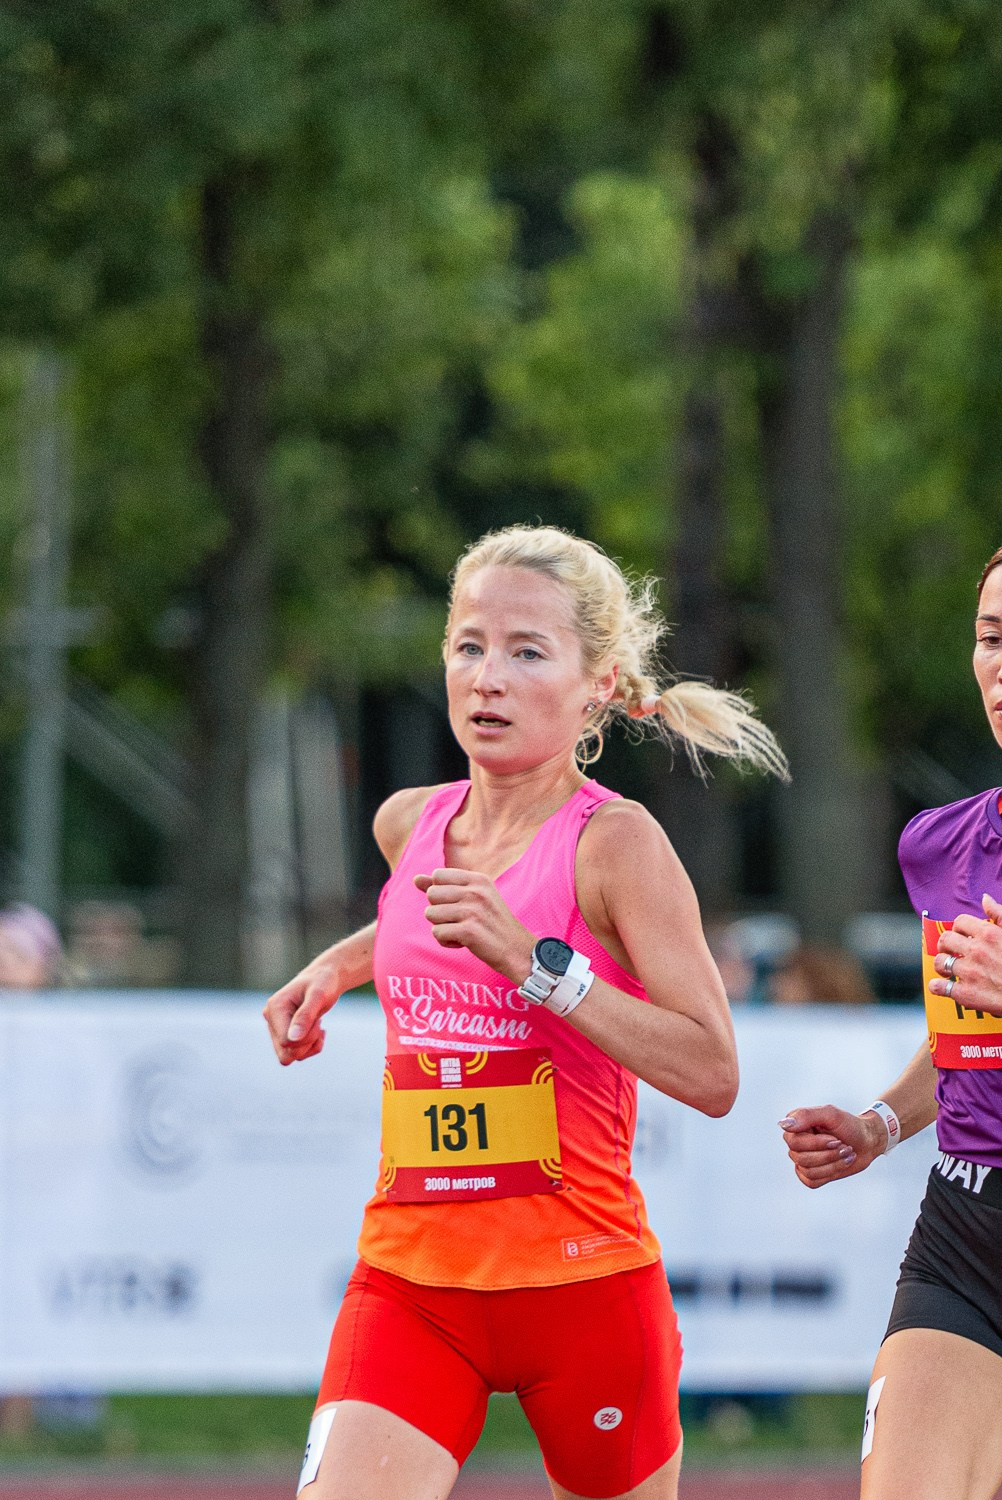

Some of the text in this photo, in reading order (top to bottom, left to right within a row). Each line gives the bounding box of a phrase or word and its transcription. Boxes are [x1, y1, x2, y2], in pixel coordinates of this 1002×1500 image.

[387, 975, 530, 1012] RUNNING
[393, 994, 532, 1040] & Sarcasm
[960, 1045, 982, 1058] 3000
[424, 1103, 489, 1151] 131
[424, 1176, 497, 1191] 3000 метров
